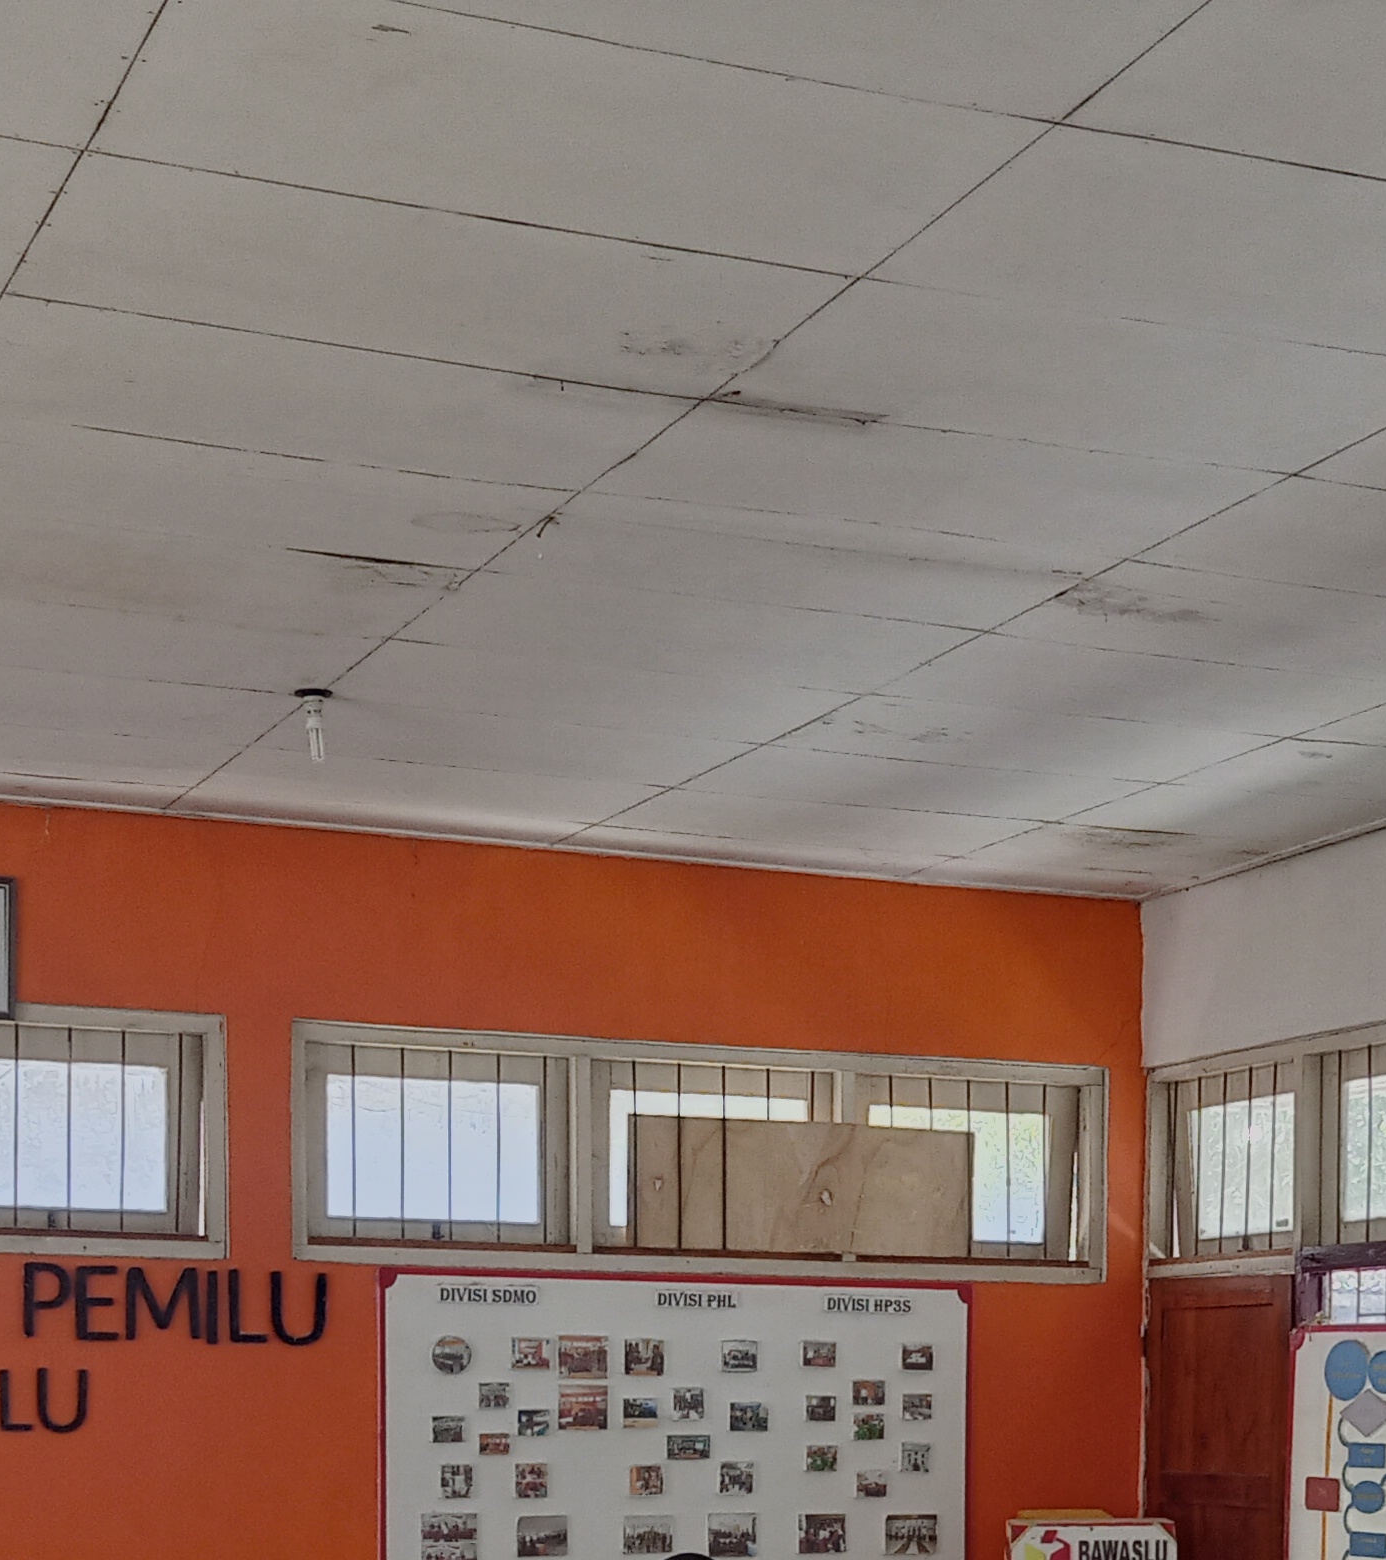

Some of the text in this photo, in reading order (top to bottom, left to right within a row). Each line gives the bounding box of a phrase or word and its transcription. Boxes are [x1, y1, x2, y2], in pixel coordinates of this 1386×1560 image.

[22, 1261, 327, 1346] PEMILU
[440, 1286, 537, 1304] DIVISI SDMO
[657, 1291, 737, 1309] DIVISI PHL
[826, 1295, 912, 1313] DIVISI HP3S
